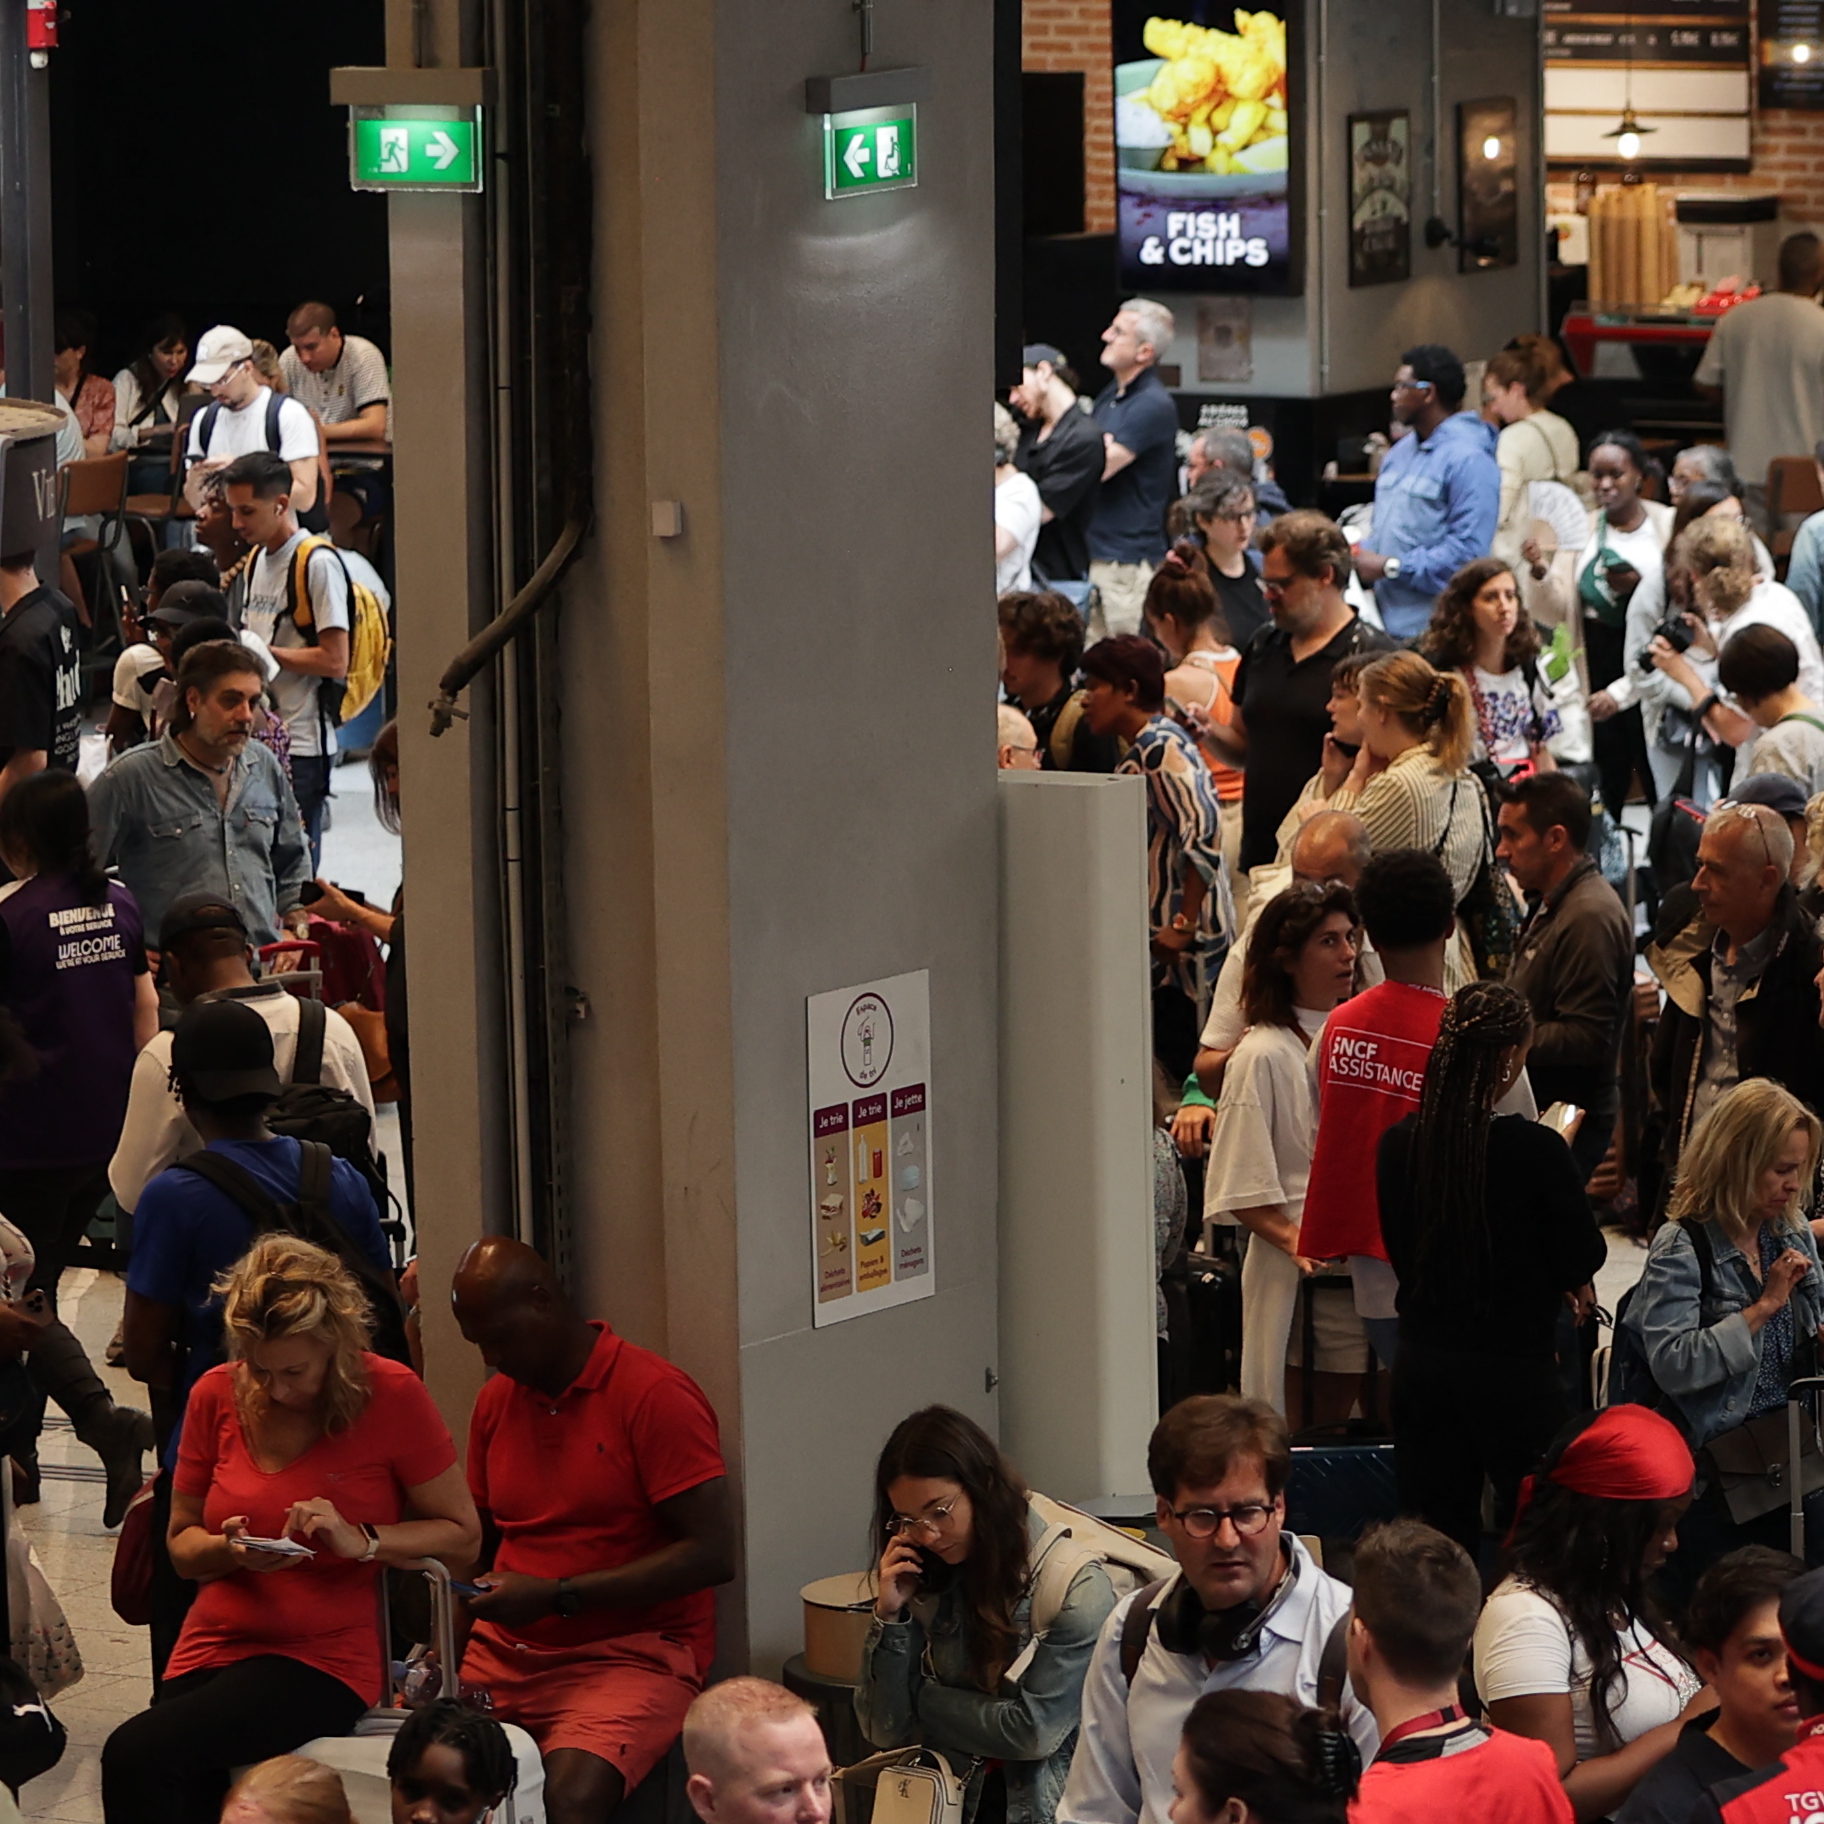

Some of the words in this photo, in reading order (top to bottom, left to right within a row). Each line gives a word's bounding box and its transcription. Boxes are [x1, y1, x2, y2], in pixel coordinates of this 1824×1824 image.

[1167, 211, 1241, 239] FISH
[1140, 236, 1164, 266] &
[1168, 237, 1270, 267] CHIPS
[58, 933, 122, 960] WELCOME
[1332, 1036, 1379, 1060] SNCF
[1328, 1056, 1425, 1091] ASSISTANCE
[857, 1106, 867, 1119] Je
[868, 1102, 882, 1116] trie
[894, 1097, 904, 1109] Je
[904, 1094, 923, 1110] jette
[819, 1115, 829, 1129] Je
[829, 1112, 844, 1126] trie
